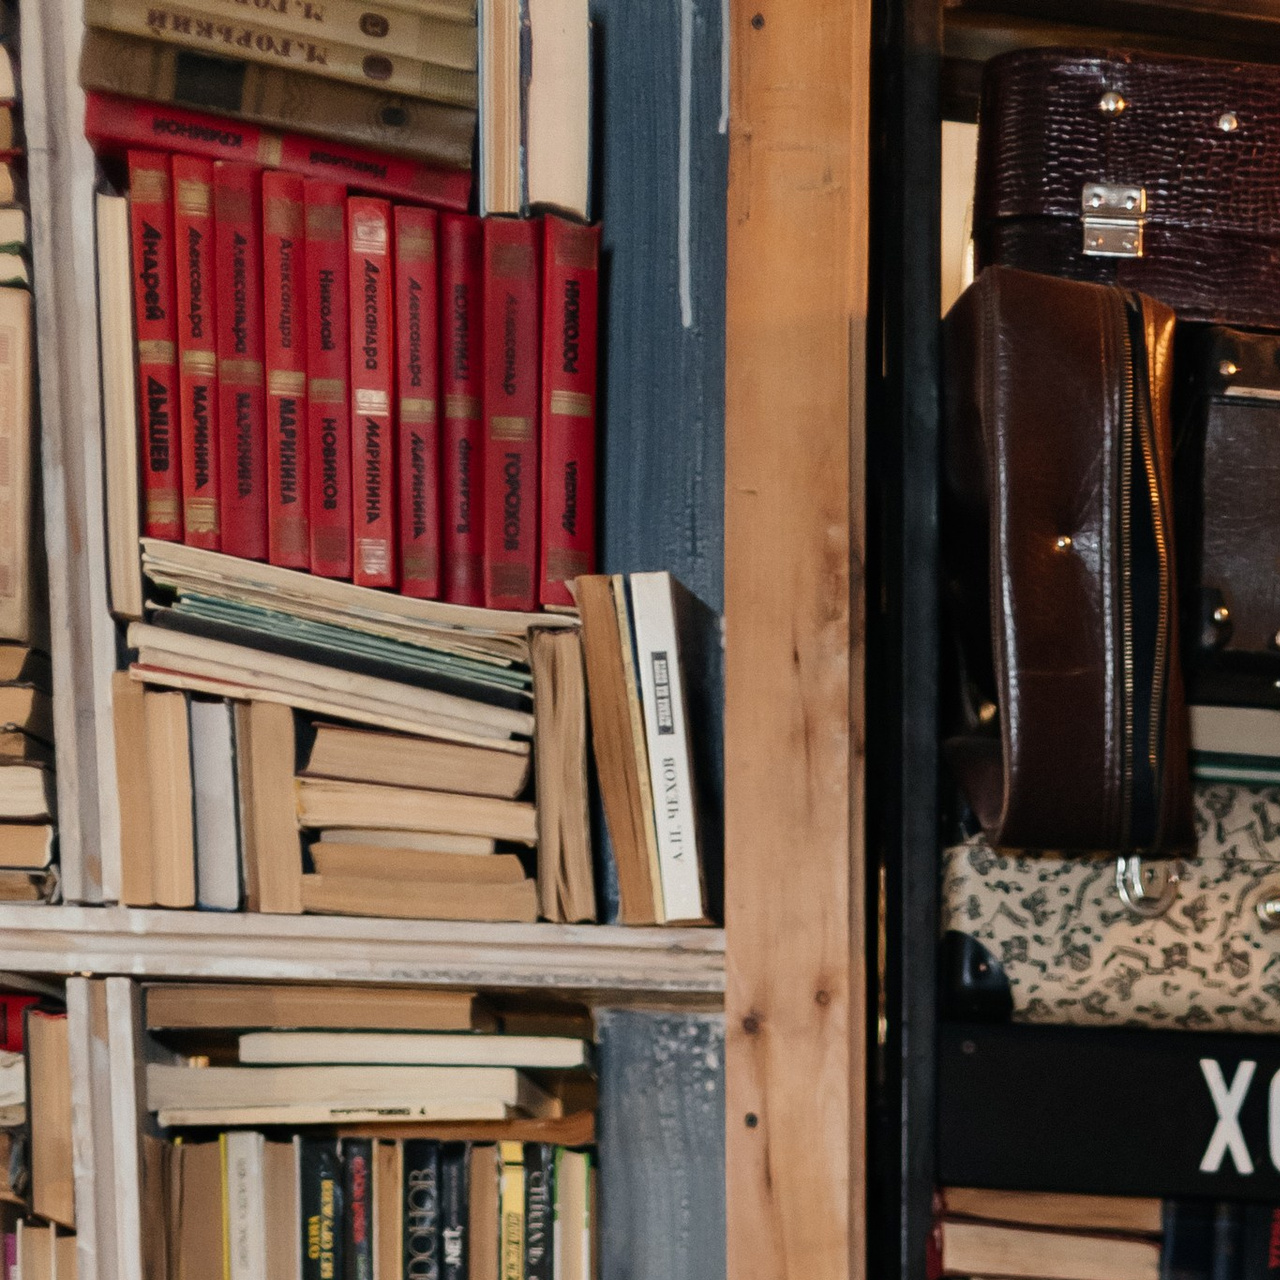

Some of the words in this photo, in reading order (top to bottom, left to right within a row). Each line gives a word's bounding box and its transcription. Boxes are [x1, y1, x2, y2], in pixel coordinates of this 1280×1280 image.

[140, 221, 166, 321] Андрей
[188, 227, 204, 338] Александра
[280, 239, 293, 347] Александра
[319, 269, 336, 350] Николай
[362, 259, 380, 369] Александра
[408, 278, 424, 387] Александра
[504, 293, 519, 395] Александр
[563, 280, 580, 374] РОГОЖИН
[148, 376, 169, 473] ДЫШЕВ
[193, 386, 208, 489] МАРИНИНА
[236, 393, 253, 497] МАРИНИНА
[280, 399, 296, 504] МАРИНИНА
[322, 418, 338, 510] НОВИКОВ
[365, 419, 382, 523] МАРИНИНА
[411, 432, 427, 538] МАРИНИНА
[504, 452, 522, 551] ГОРОХОВ
[663, 757, 679, 819] ЧЕХОВ
